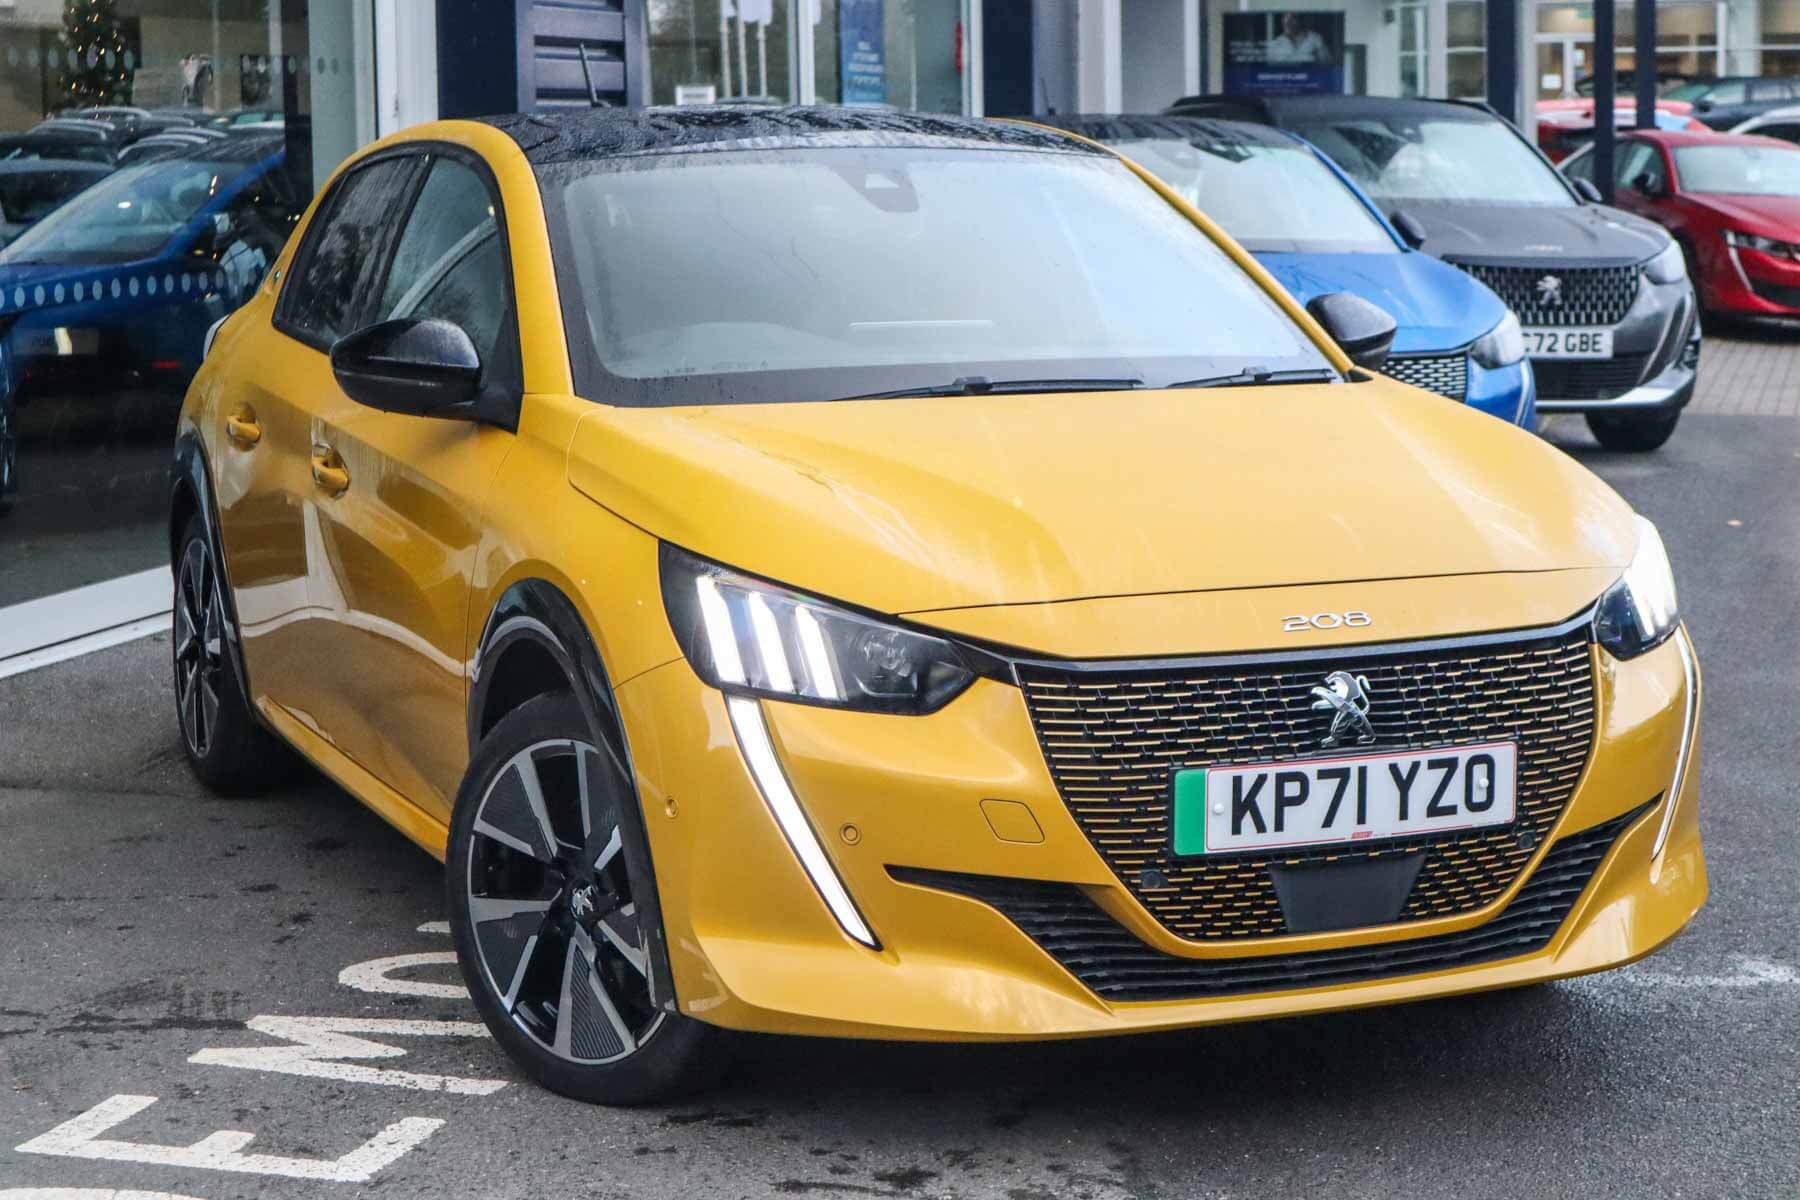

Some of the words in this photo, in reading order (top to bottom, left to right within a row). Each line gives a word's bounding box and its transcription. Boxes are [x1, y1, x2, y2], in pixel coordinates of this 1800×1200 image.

[1564, 332, 1603, 353] GBE
[1280, 610, 1372, 632] 208
[1231, 765, 1368, 837] KP71
[1388, 753, 1496, 821] YZO
